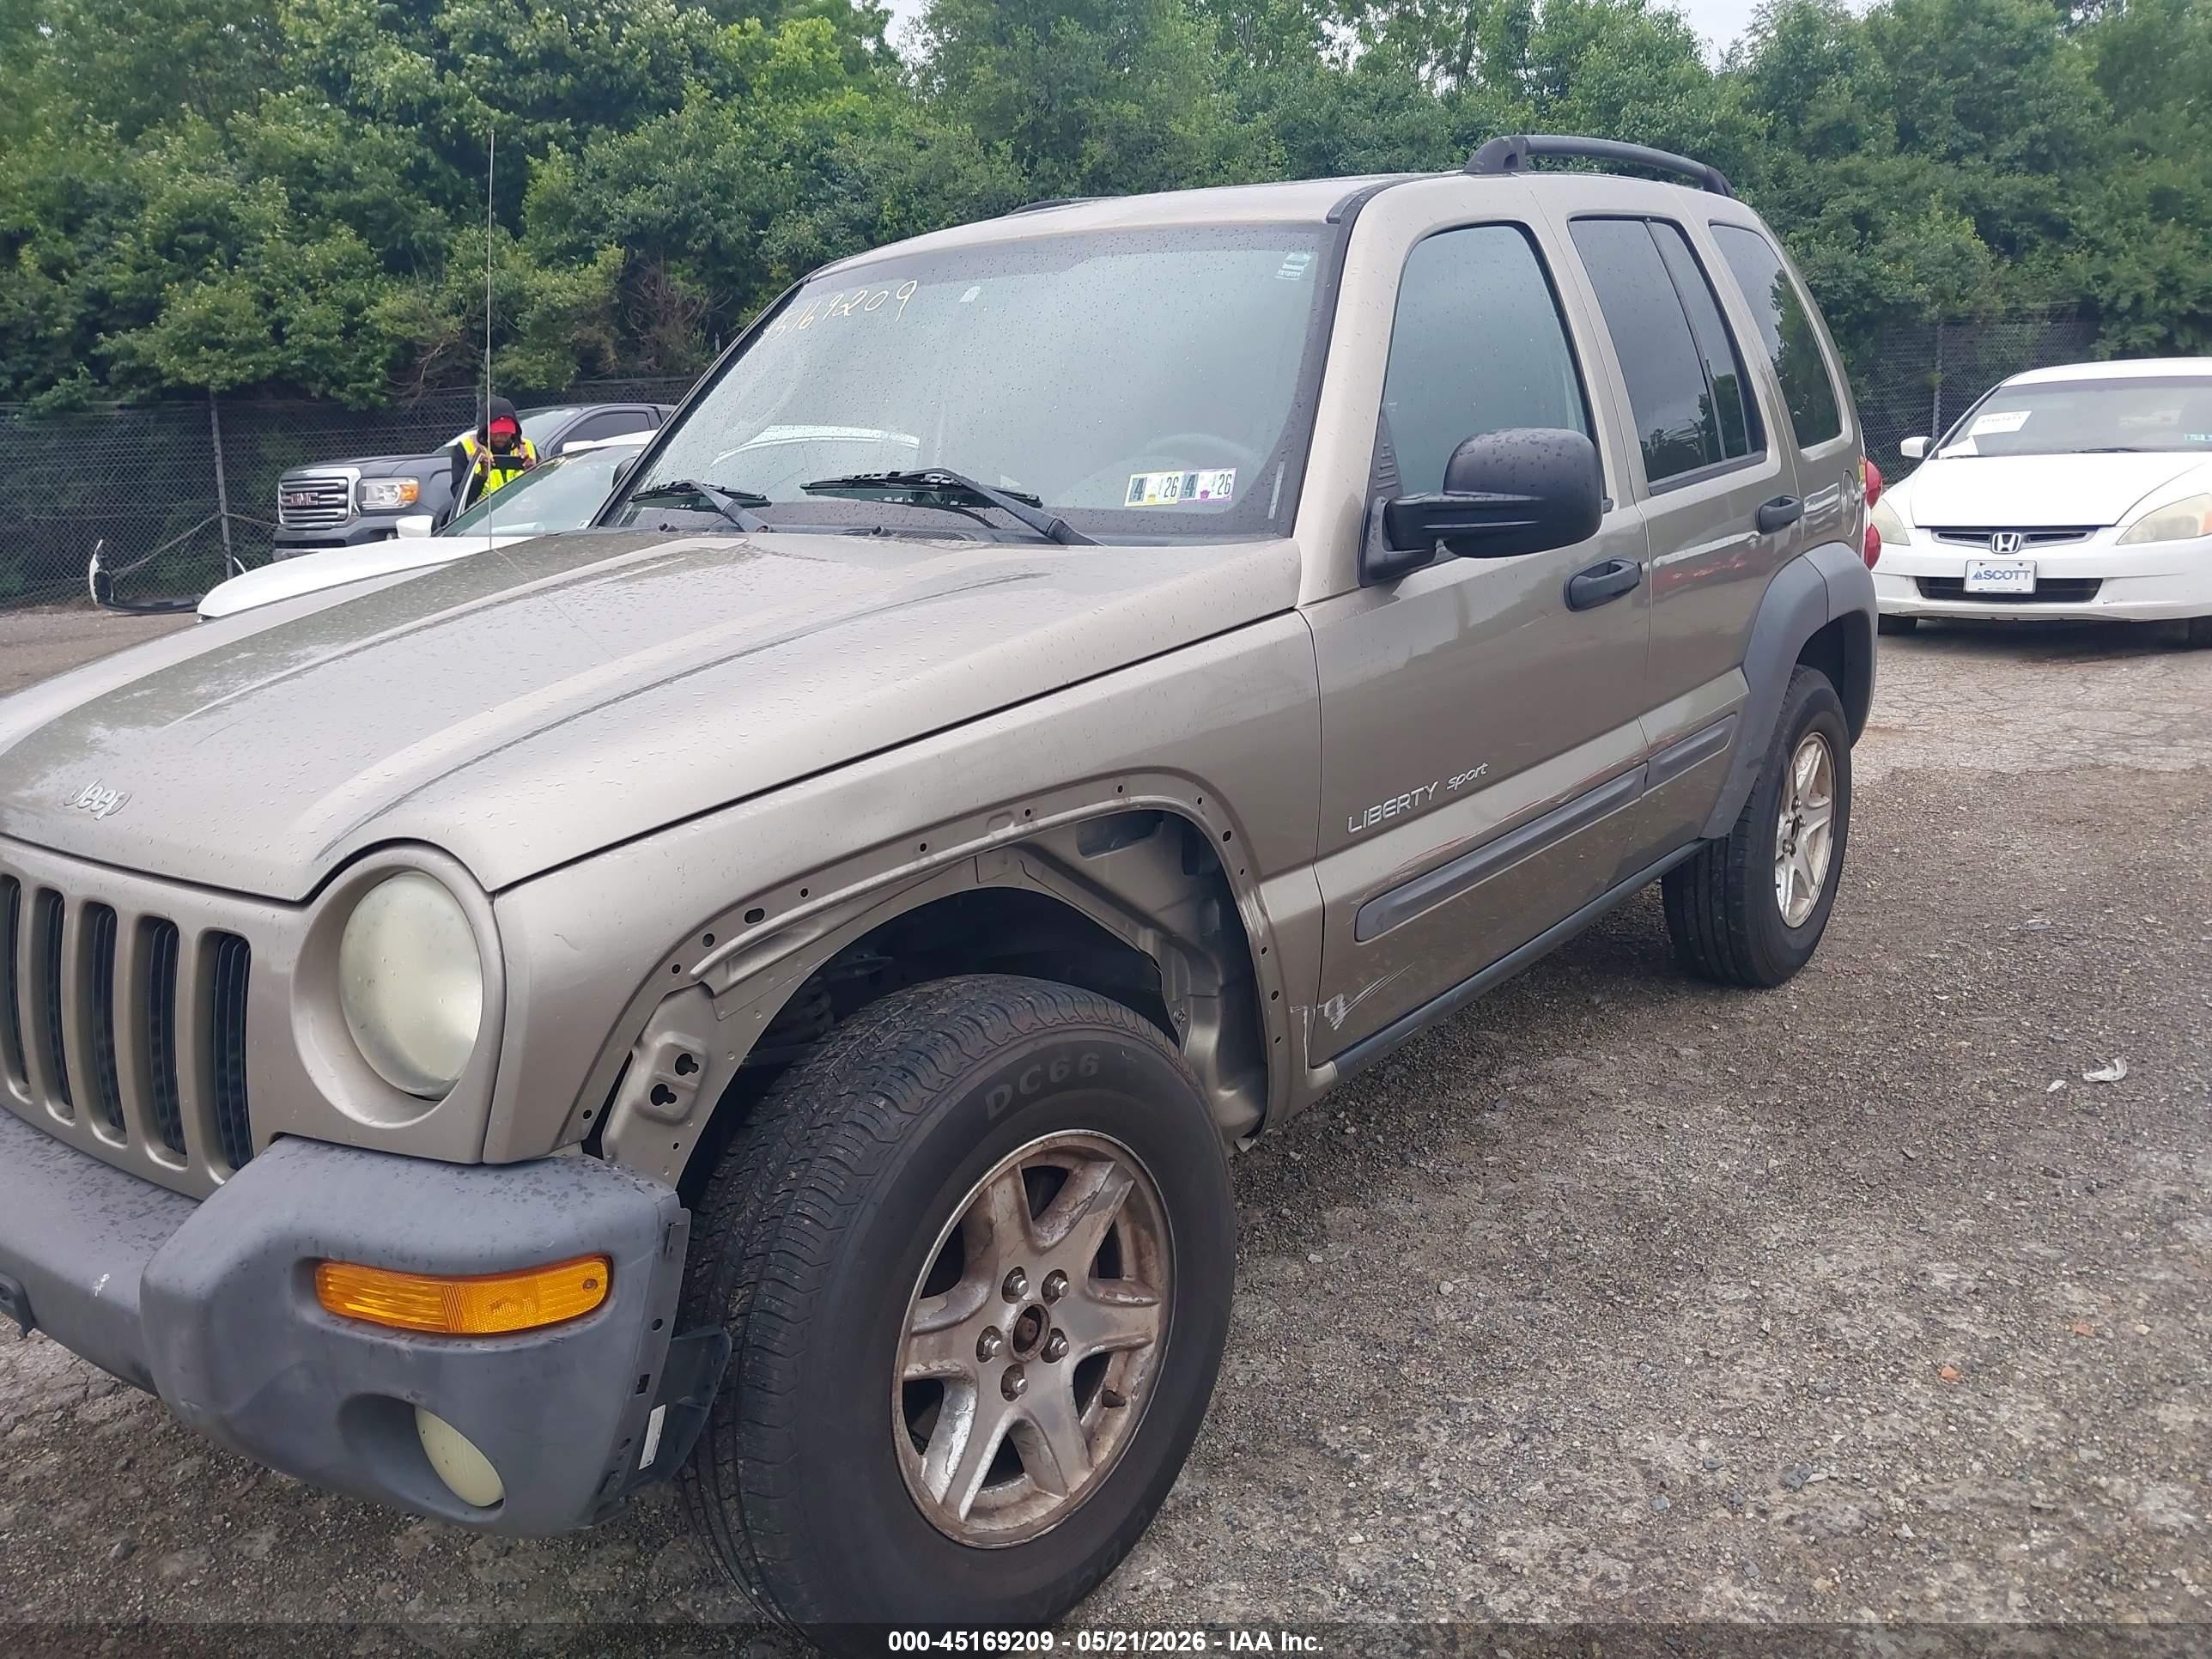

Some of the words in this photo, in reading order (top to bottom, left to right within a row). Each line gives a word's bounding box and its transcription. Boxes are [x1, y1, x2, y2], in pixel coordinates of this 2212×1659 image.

[290, 492, 319, 506] GMC
[1164, 476, 1179, 498] 26
[1217, 473, 1232, 495] 26
[64, 778, 132, 821] Jeep
[1347, 781, 1438, 834] LIBERTY
[1446, 763, 1489, 791] sport
[986, 1052, 1100, 1121] DC66
